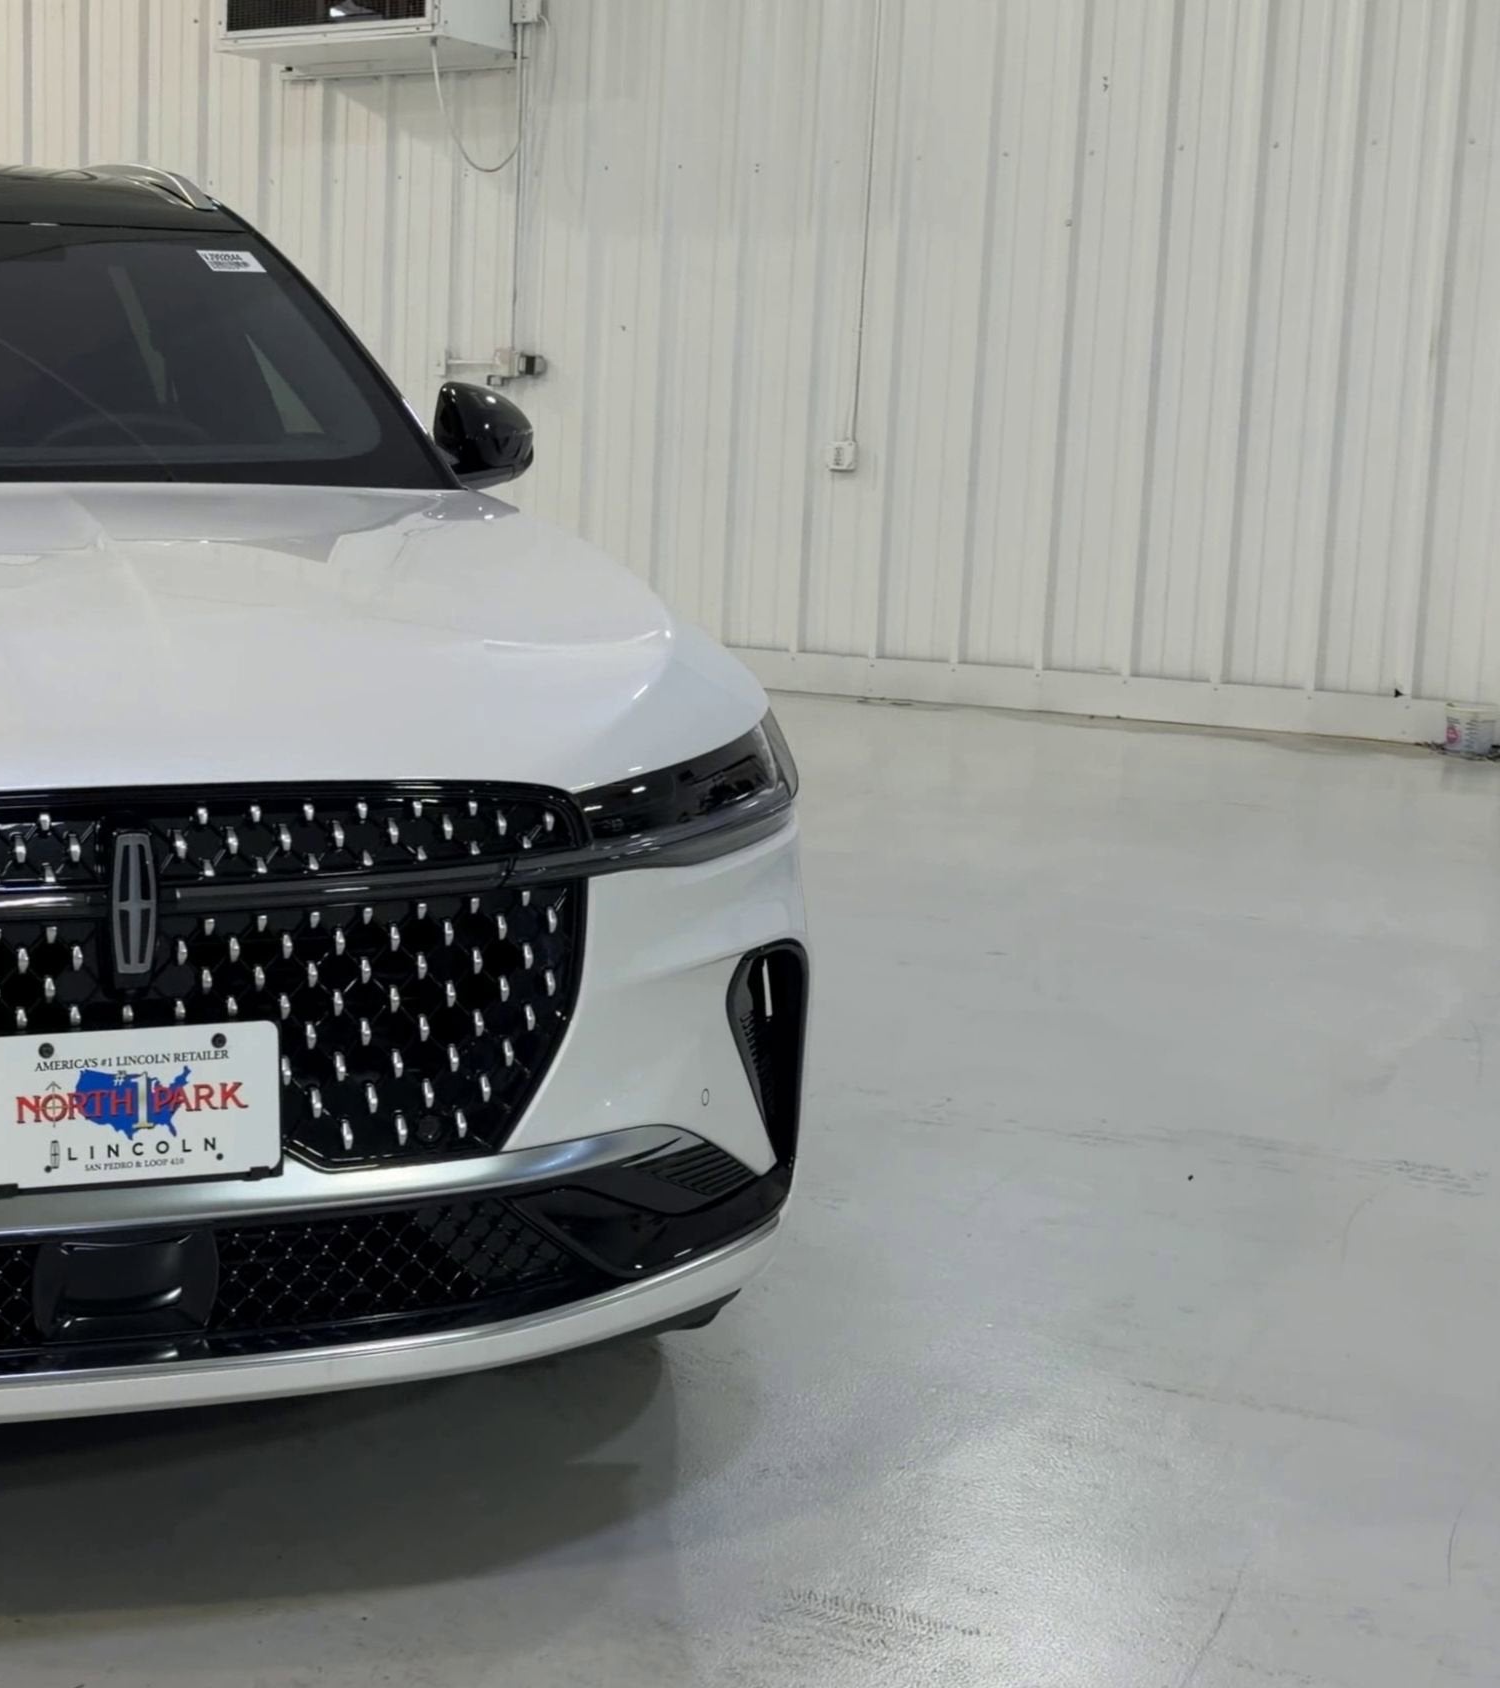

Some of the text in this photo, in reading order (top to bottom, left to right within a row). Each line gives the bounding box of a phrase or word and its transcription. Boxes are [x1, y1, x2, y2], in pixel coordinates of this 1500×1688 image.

[34, 1049, 229, 1072] AMERICA'S #1 LINCOLN RETAILER
[15, 1082, 249, 1124] NORTH PARK
[67, 1137, 217, 1161] LINCOLN
[85, 1163, 102, 1171] SAN
[104, 1161, 134, 1170] PEDRO
[144, 1158, 168, 1167] LOOP
